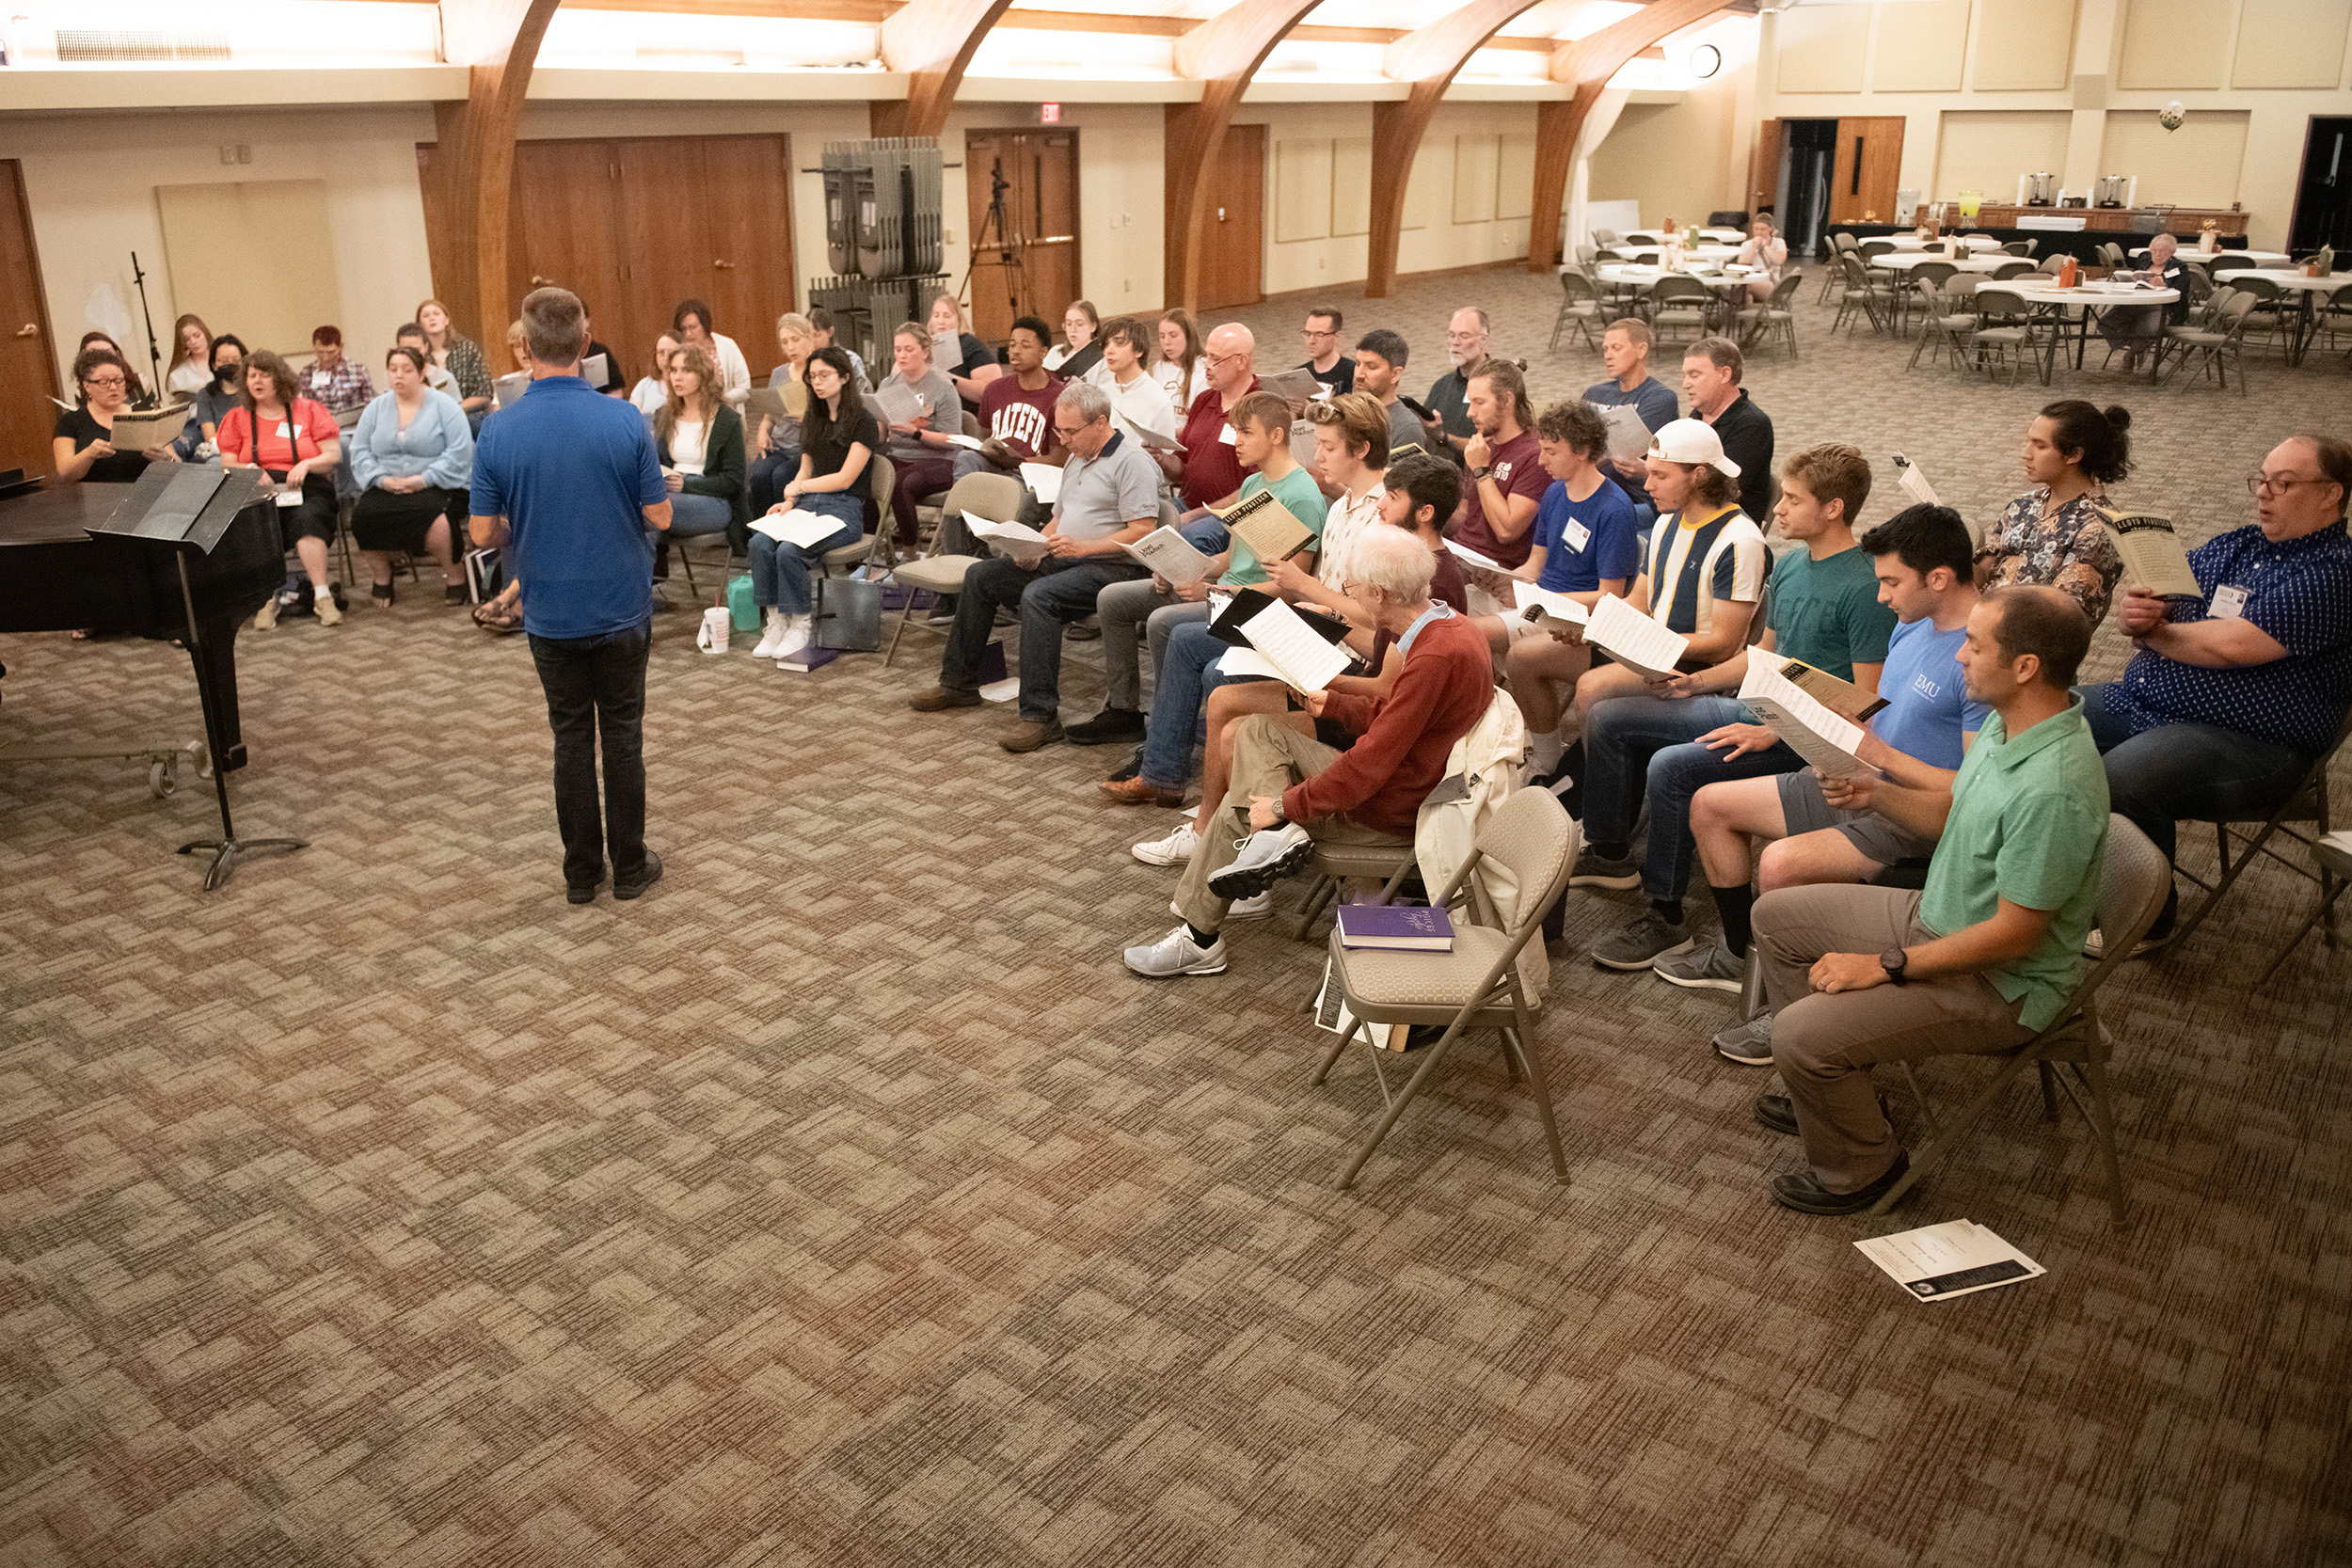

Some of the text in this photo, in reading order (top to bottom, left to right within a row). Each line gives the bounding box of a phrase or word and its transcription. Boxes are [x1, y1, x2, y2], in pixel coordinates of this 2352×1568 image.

[1224, 493, 1269, 523] LLOYD PFAUTSCH
[2116, 517, 2141, 530] LLOYD
[1914, 673, 1942, 698] EMU
